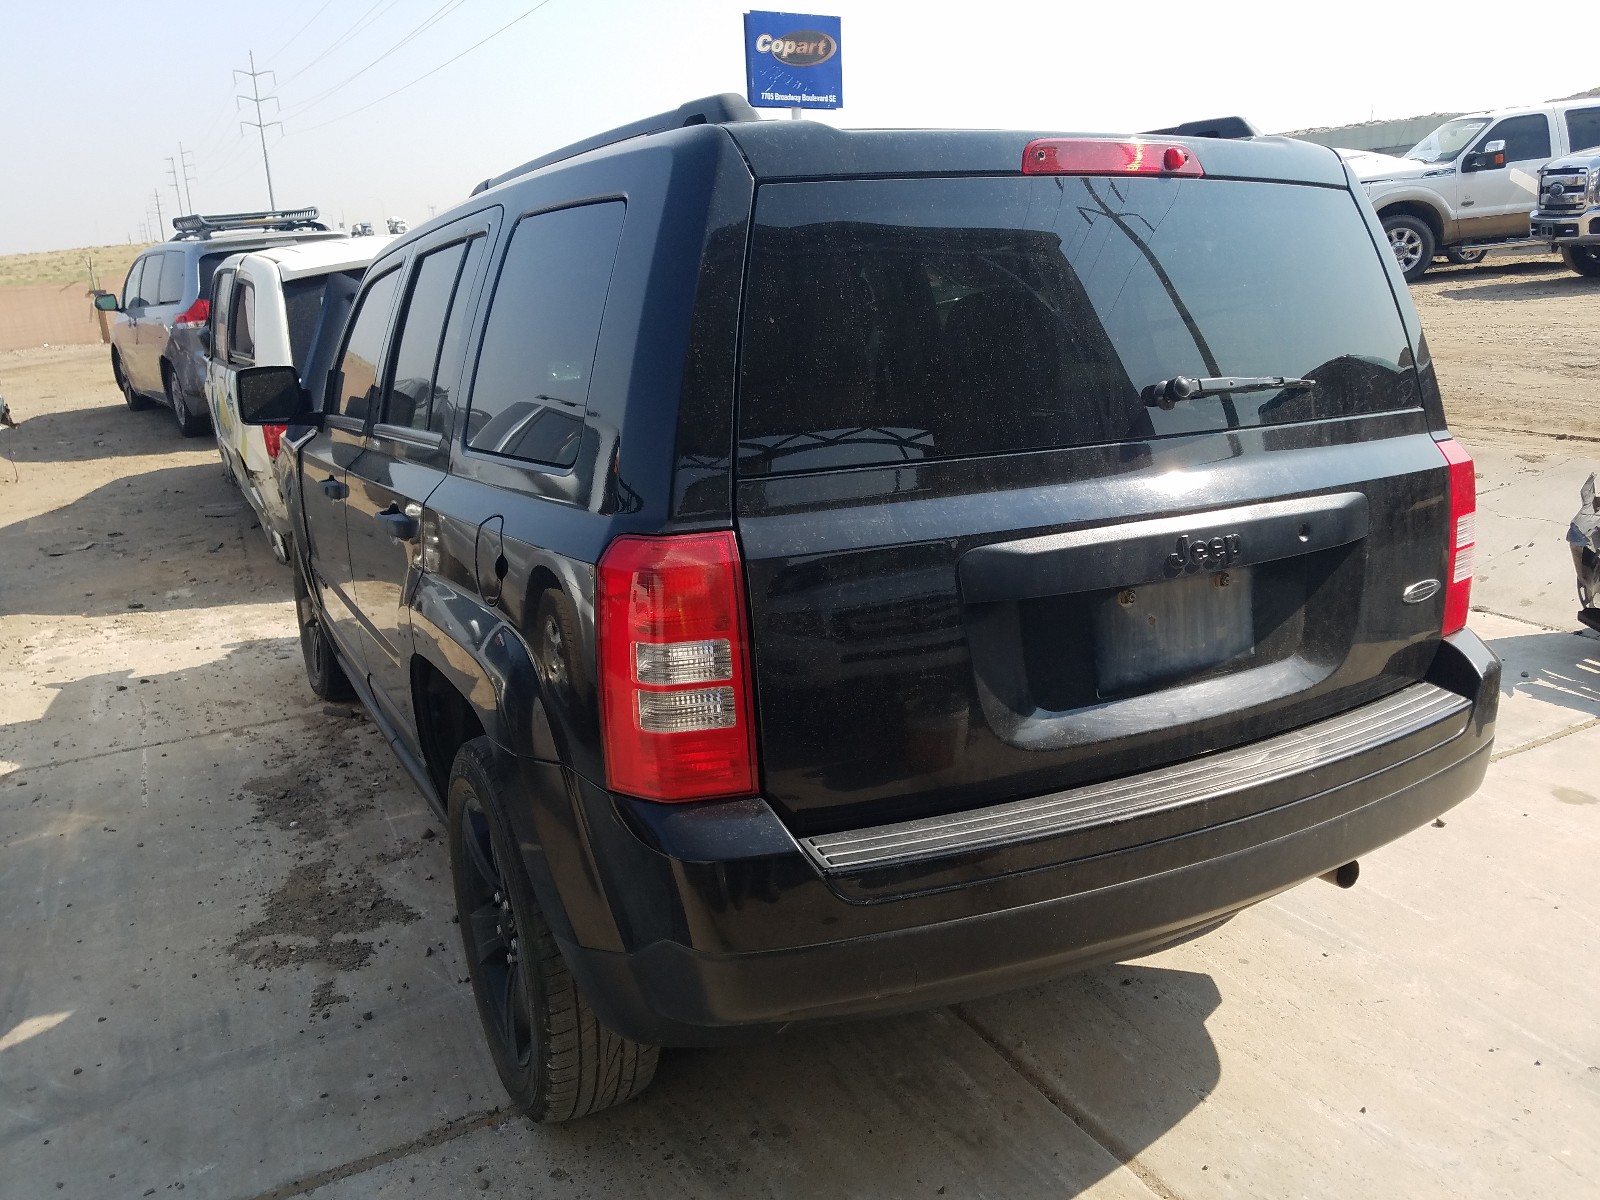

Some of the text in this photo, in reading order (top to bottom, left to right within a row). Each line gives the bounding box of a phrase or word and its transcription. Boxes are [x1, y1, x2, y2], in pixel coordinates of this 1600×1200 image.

[756, 33, 827, 58] Copart
[760, 92, 837, 103] 7705 Broadway Boulevard SE
[1168, 534, 1241, 569] Jeep
